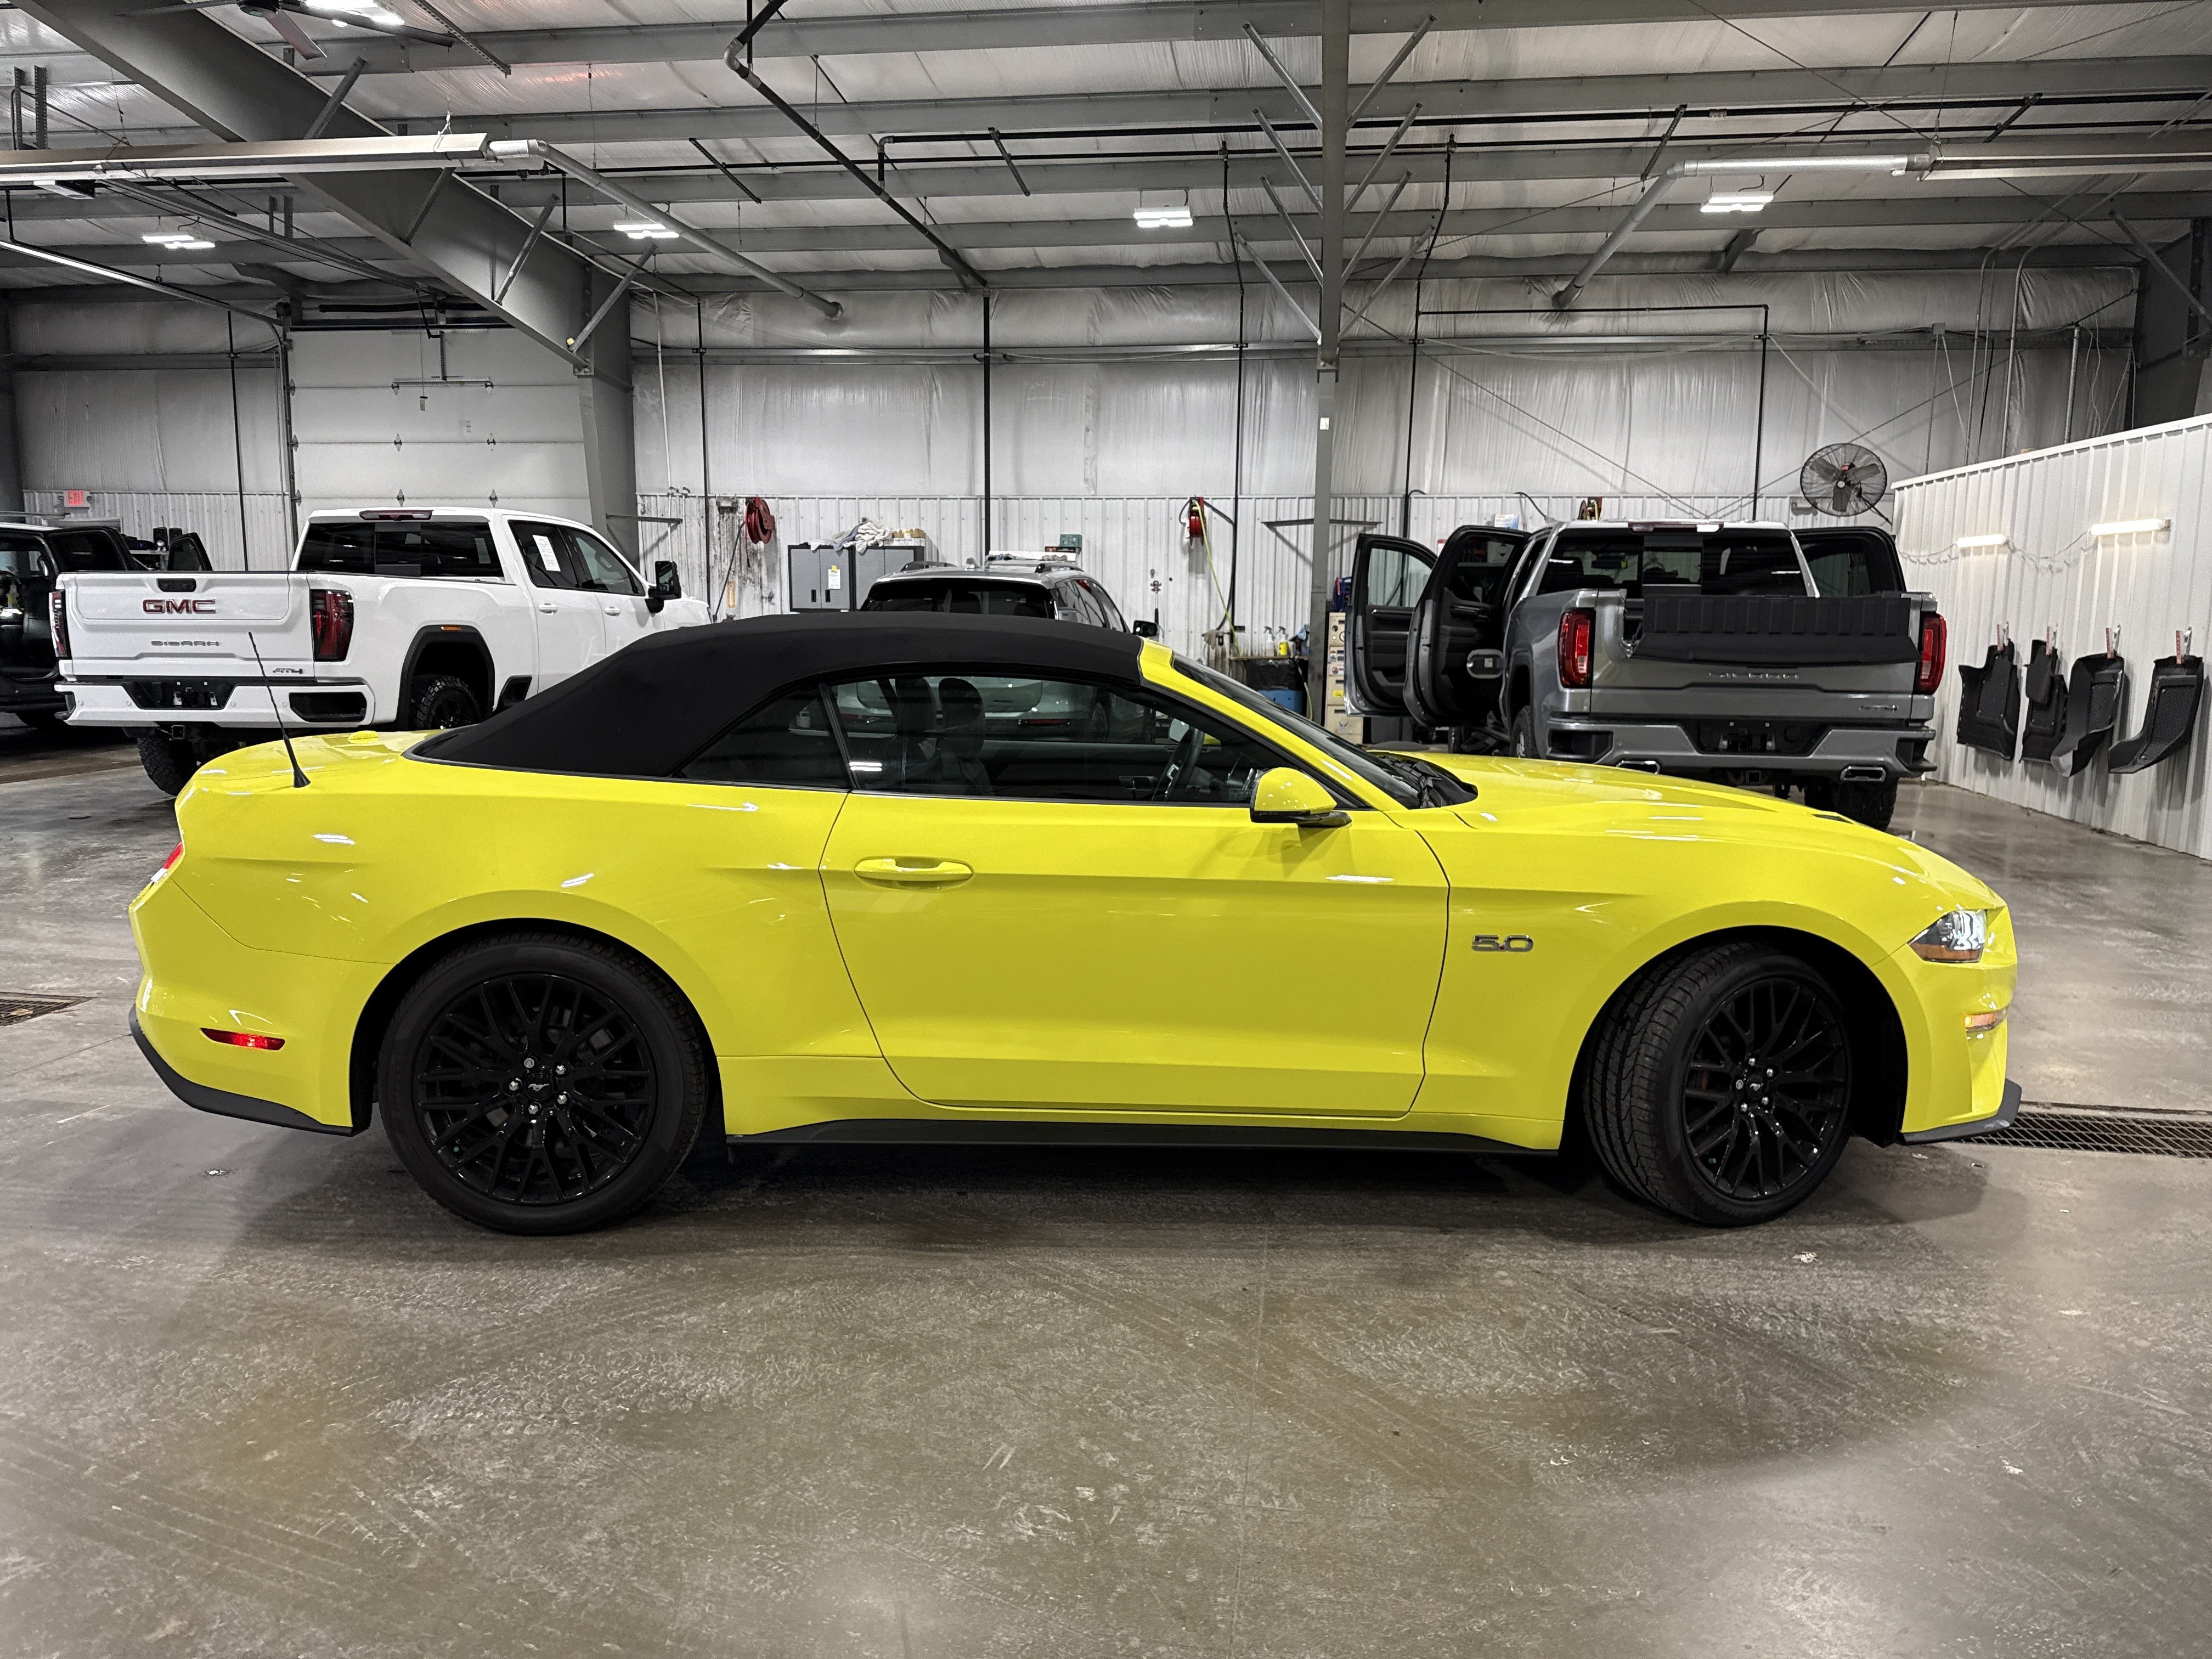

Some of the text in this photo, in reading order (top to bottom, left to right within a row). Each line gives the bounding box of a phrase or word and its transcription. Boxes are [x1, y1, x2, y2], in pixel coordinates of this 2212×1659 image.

[67, 492, 83, 505] EXIT
[143, 599, 216, 614] GMC
[1471, 934, 1534, 952] 5.0
